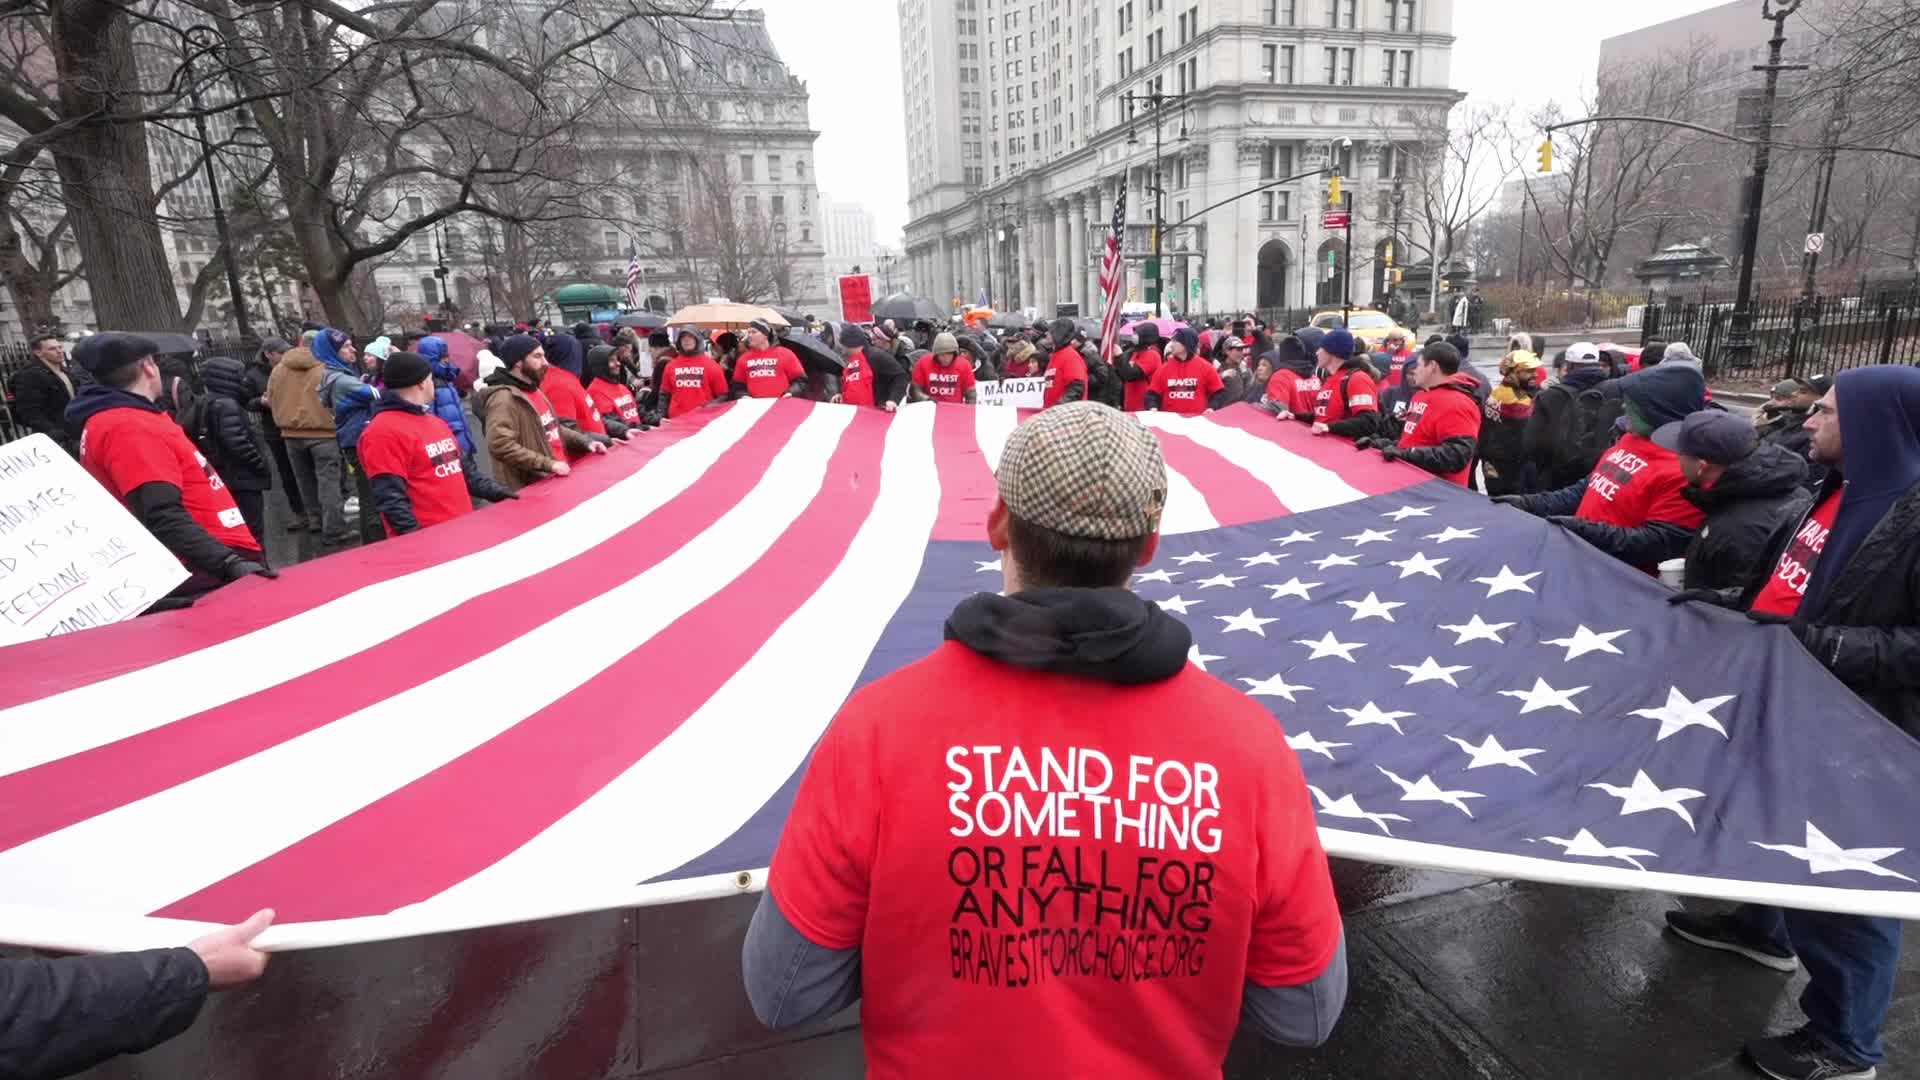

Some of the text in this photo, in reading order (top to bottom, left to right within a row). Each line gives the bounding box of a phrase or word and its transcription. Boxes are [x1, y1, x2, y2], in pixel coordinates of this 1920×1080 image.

[675, 367, 704, 375] BRAVEST
[747, 358, 777, 367] BRAVEST
[749, 369, 776, 378] CHOICE
[676, 379, 701, 388] CHOICE
[928, 373, 959, 383] BRAVEST
[985, 381, 1044, 396] MANDAT
[1168, 378, 1198, 387] BRAVEST
[1169, 391, 1195, 399] CHOICE
[0, 448, 52, 481] HING
[1607, 449, 1648, 474] AVEST
[0, 487, 77, 535] ANDATES
[24, 538, 49, 559] IS
[0, 561, 90, 625] FEEDING
[945, 745, 1221, 809] STAND FOR
[948, 791, 1223, 853] SOMETHING
[948, 845, 1215, 902] OR FALL FOR
[951, 885, 1212, 933] ANYTHING
[949, 926, 1206, 987] BRAVESTFORCHOICE.ORG
